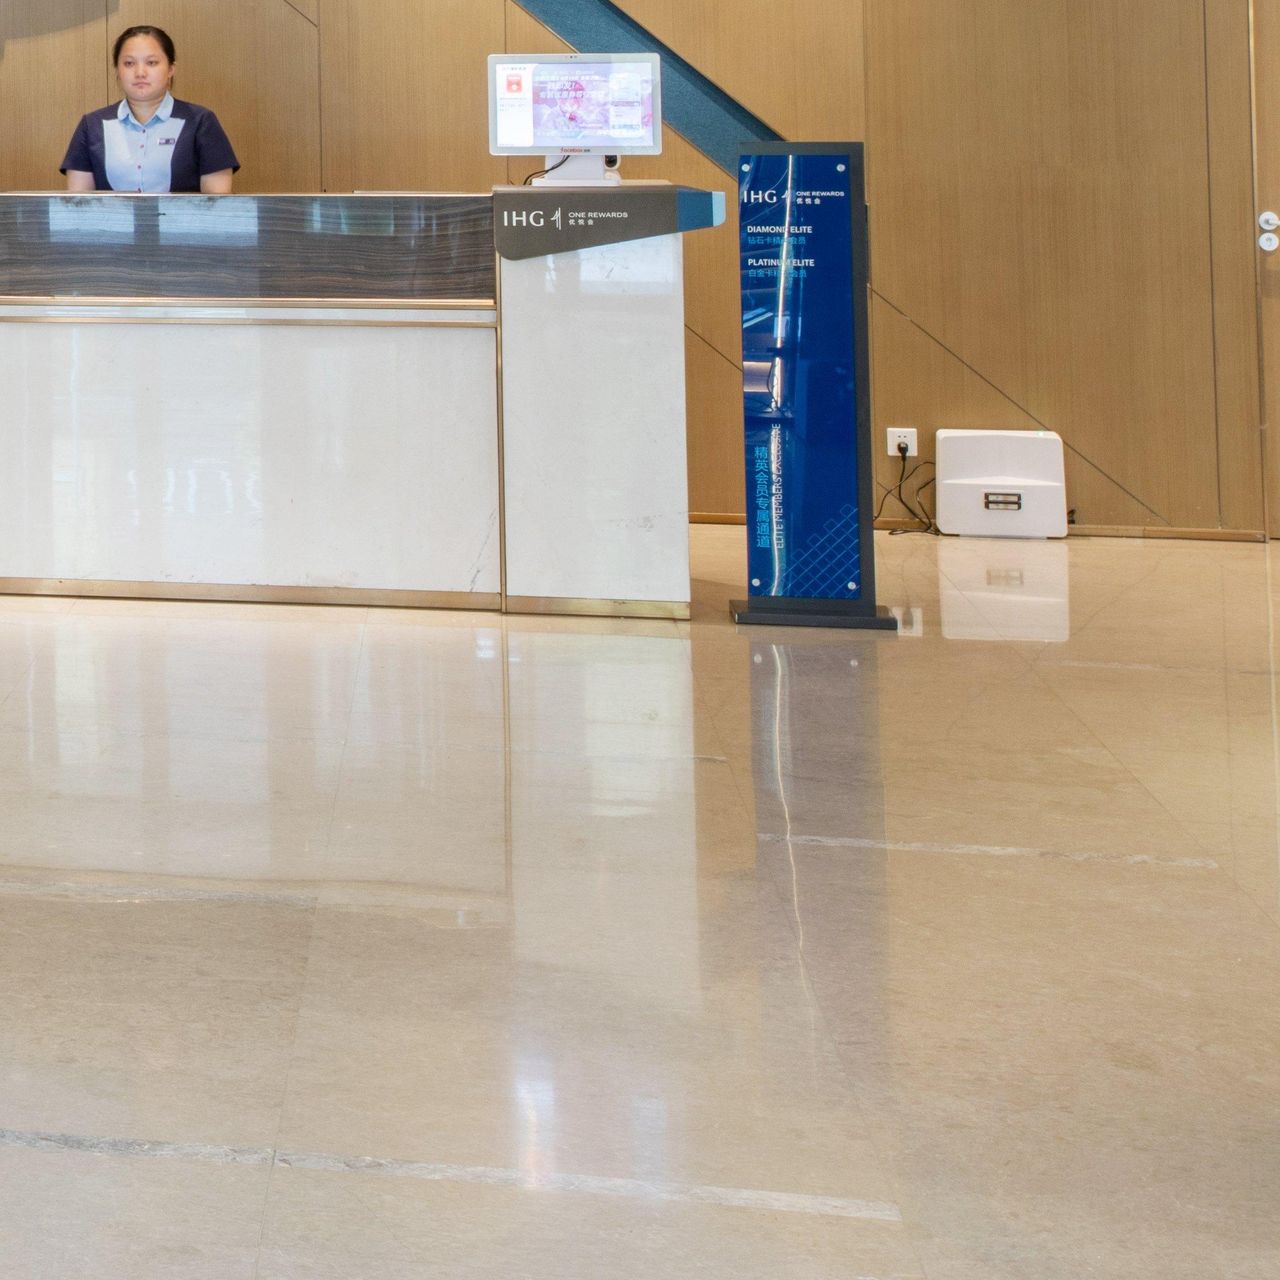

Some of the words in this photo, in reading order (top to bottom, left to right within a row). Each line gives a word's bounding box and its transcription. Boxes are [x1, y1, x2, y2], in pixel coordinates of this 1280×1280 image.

[744, 190, 777, 203] IHG
[503, 210, 545, 227] IHG
[747, 225, 788, 234] DIAMOND
[790, 225, 813, 234] ELITE
[792, 258, 815, 267] ELITE
[754, 446, 770, 548] 精英会员专属通道
[773, 477, 784, 522] MEMBERS
[775, 524, 784, 549] ELITE
